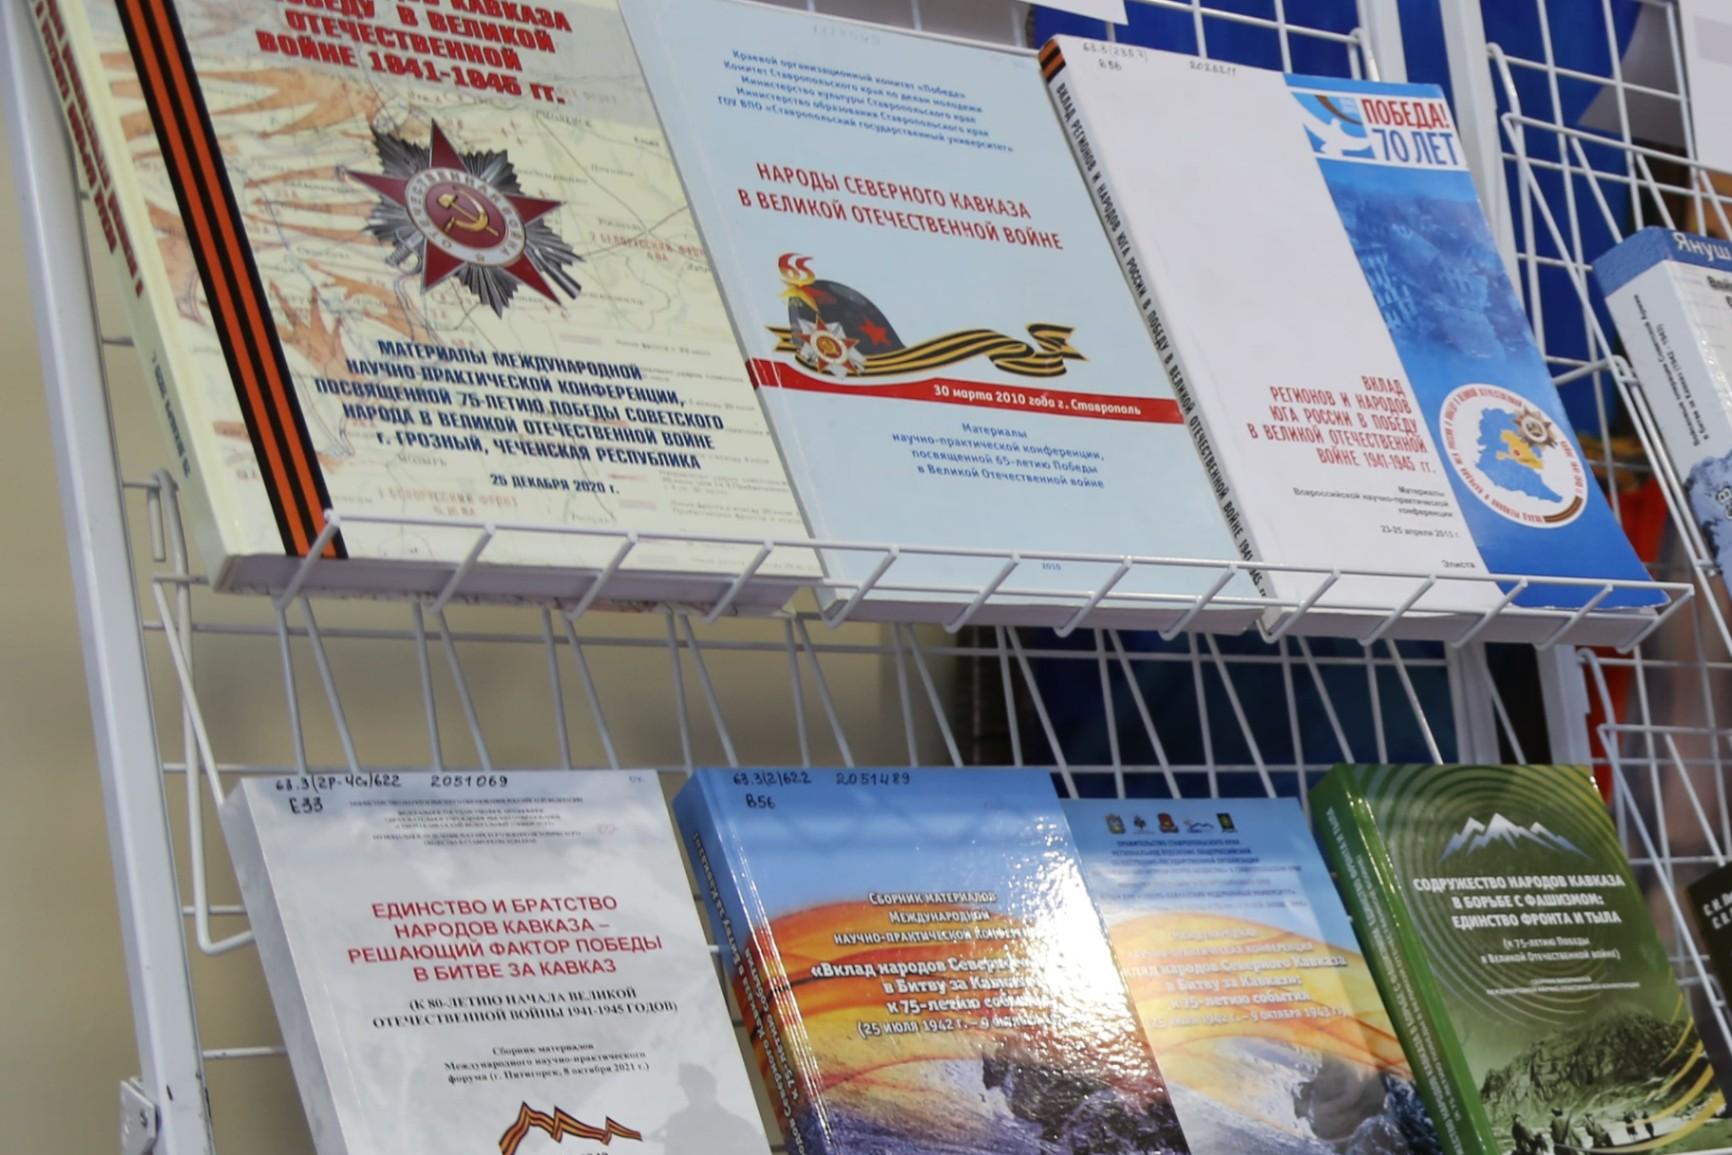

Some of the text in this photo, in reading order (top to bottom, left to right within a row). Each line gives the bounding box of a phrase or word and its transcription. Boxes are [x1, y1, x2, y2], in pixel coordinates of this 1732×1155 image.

[285, 10, 523, 71] ОТЕЧЕСТВЕННОЙ
[397, 4, 556, 53] В ВЕЛИКОЙ
[255, 30, 359, 67] ВОЙНЕ
[367, 51, 522, 96] 1941-1945
[1361, 98, 1452, 131] ПОБЕДА!
[1371, 128, 1461, 168] 70 ЛЕТ
[756, 162, 1032, 220] НАРОДЫ СЕВЕРНОГО КАВКАЗА
[737, 188, 1064, 251] В ВЕЛИКОЙ ОТЕЧЕСТВЕННОЙ ВОЙНЕ
[1673, 231, 1731, 262] Януш
[377, 340, 642, 381] МАТЕРИАЛЫ МЕЖДУНАРОДНОЙ
[345, 358, 685, 407] НАУЧНО-ПРАКТИЧЕСКОЙ КОНФЕРЕНЦИИ,
[1361, 375, 1406, 398] ВКЛАД
[933, 384, 950, 398] 30
[952, 387, 993, 403] марта
[996, 390, 1026, 406] 2010
[1071, 398, 1142, 416] Ставрополь
[1269, 386, 1413, 416] РЕГИОНОВ И НАРОДОВ
[962, 421, 1028, 439] Материалы
[1269, 405, 1419, 436] ЮГА РОССИИ В ПОБЕДУ
[891, 431, 1021, 454] научно-практической
[490, 474, 506, 487] 25
[511, 475, 570, 493] ДЕКАБРЯ
[573, 480, 606, 495] 2020
[1413, 873, 1626, 894] СОДРУЖЕСТВО НАРОДОВ КАВКАЗА
[371, 895, 618, 920] ЕДИНСТВО И БРАТСТВО
[1452, 896, 1461, 909] В
[1463, 894, 1512, 909] БОРЬБЕ
[1525, 893, 1605, 908] ФАШИЗМОМ:
[394, 917, 594, 941] НАРОДОВ КАВКАЗА
[1452, 910, 1623, 930] ЕДИНСТВО ФРОНТА И ТЫЛА
[347, 935, 663, 964] РЕШАЮЩИЙ ФАКТОР ПОБЕДЫ
[413, 959, 617, 983] В БИТВЕ ЗА КАВКАЗ
[878, 959, 946, 977] народов
